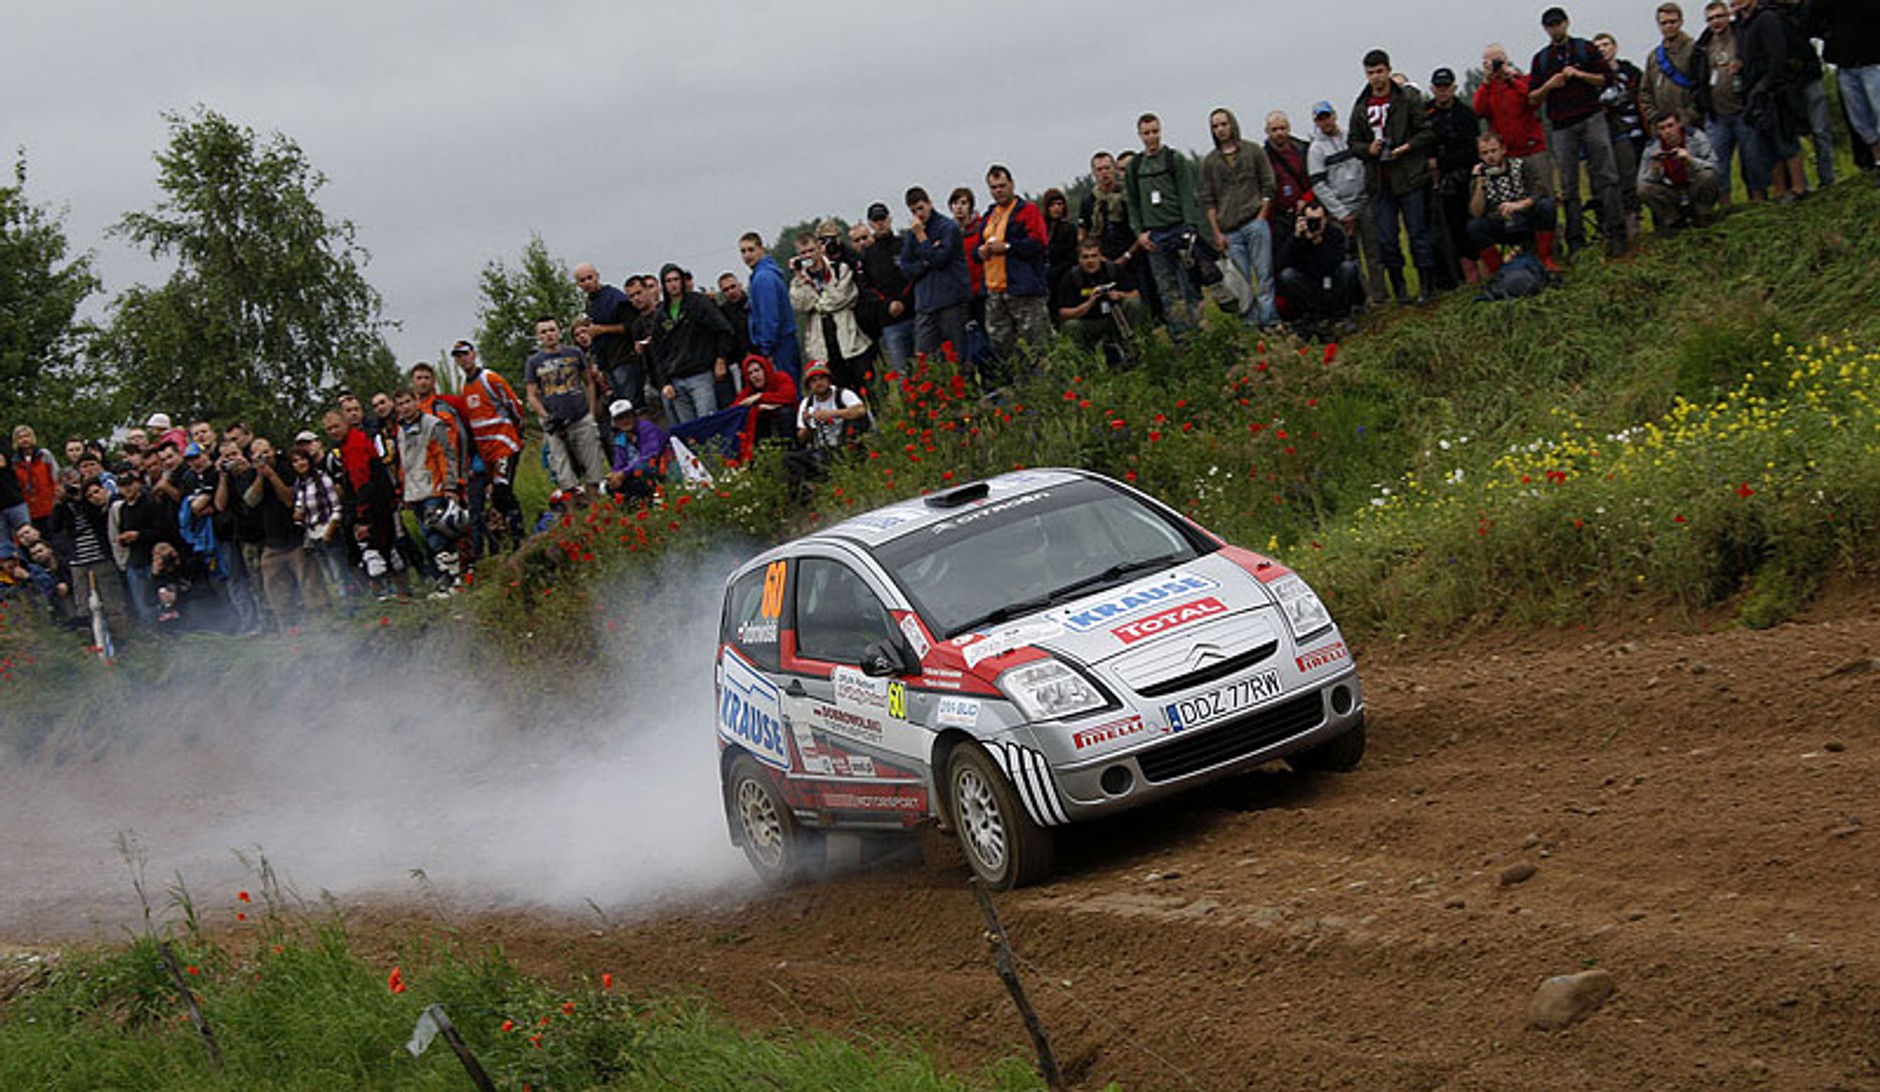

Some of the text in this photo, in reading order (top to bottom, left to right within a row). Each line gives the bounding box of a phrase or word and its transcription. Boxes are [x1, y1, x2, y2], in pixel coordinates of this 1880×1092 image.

[761, 560, 787, 619] 60
[1067, 576, 1209, 627] KRAUSE
[1118, 603, 1222, 637] TOTAL
[1295, 641, 1348, 673] PIRELLI
[887, 680, 907, 720] 60
[1180, 670, 1282, 725] DDZ 77RW
[721, 685, 784, 757] KRAUSE
[1072, 714, 1144, 750] PIRELLI
